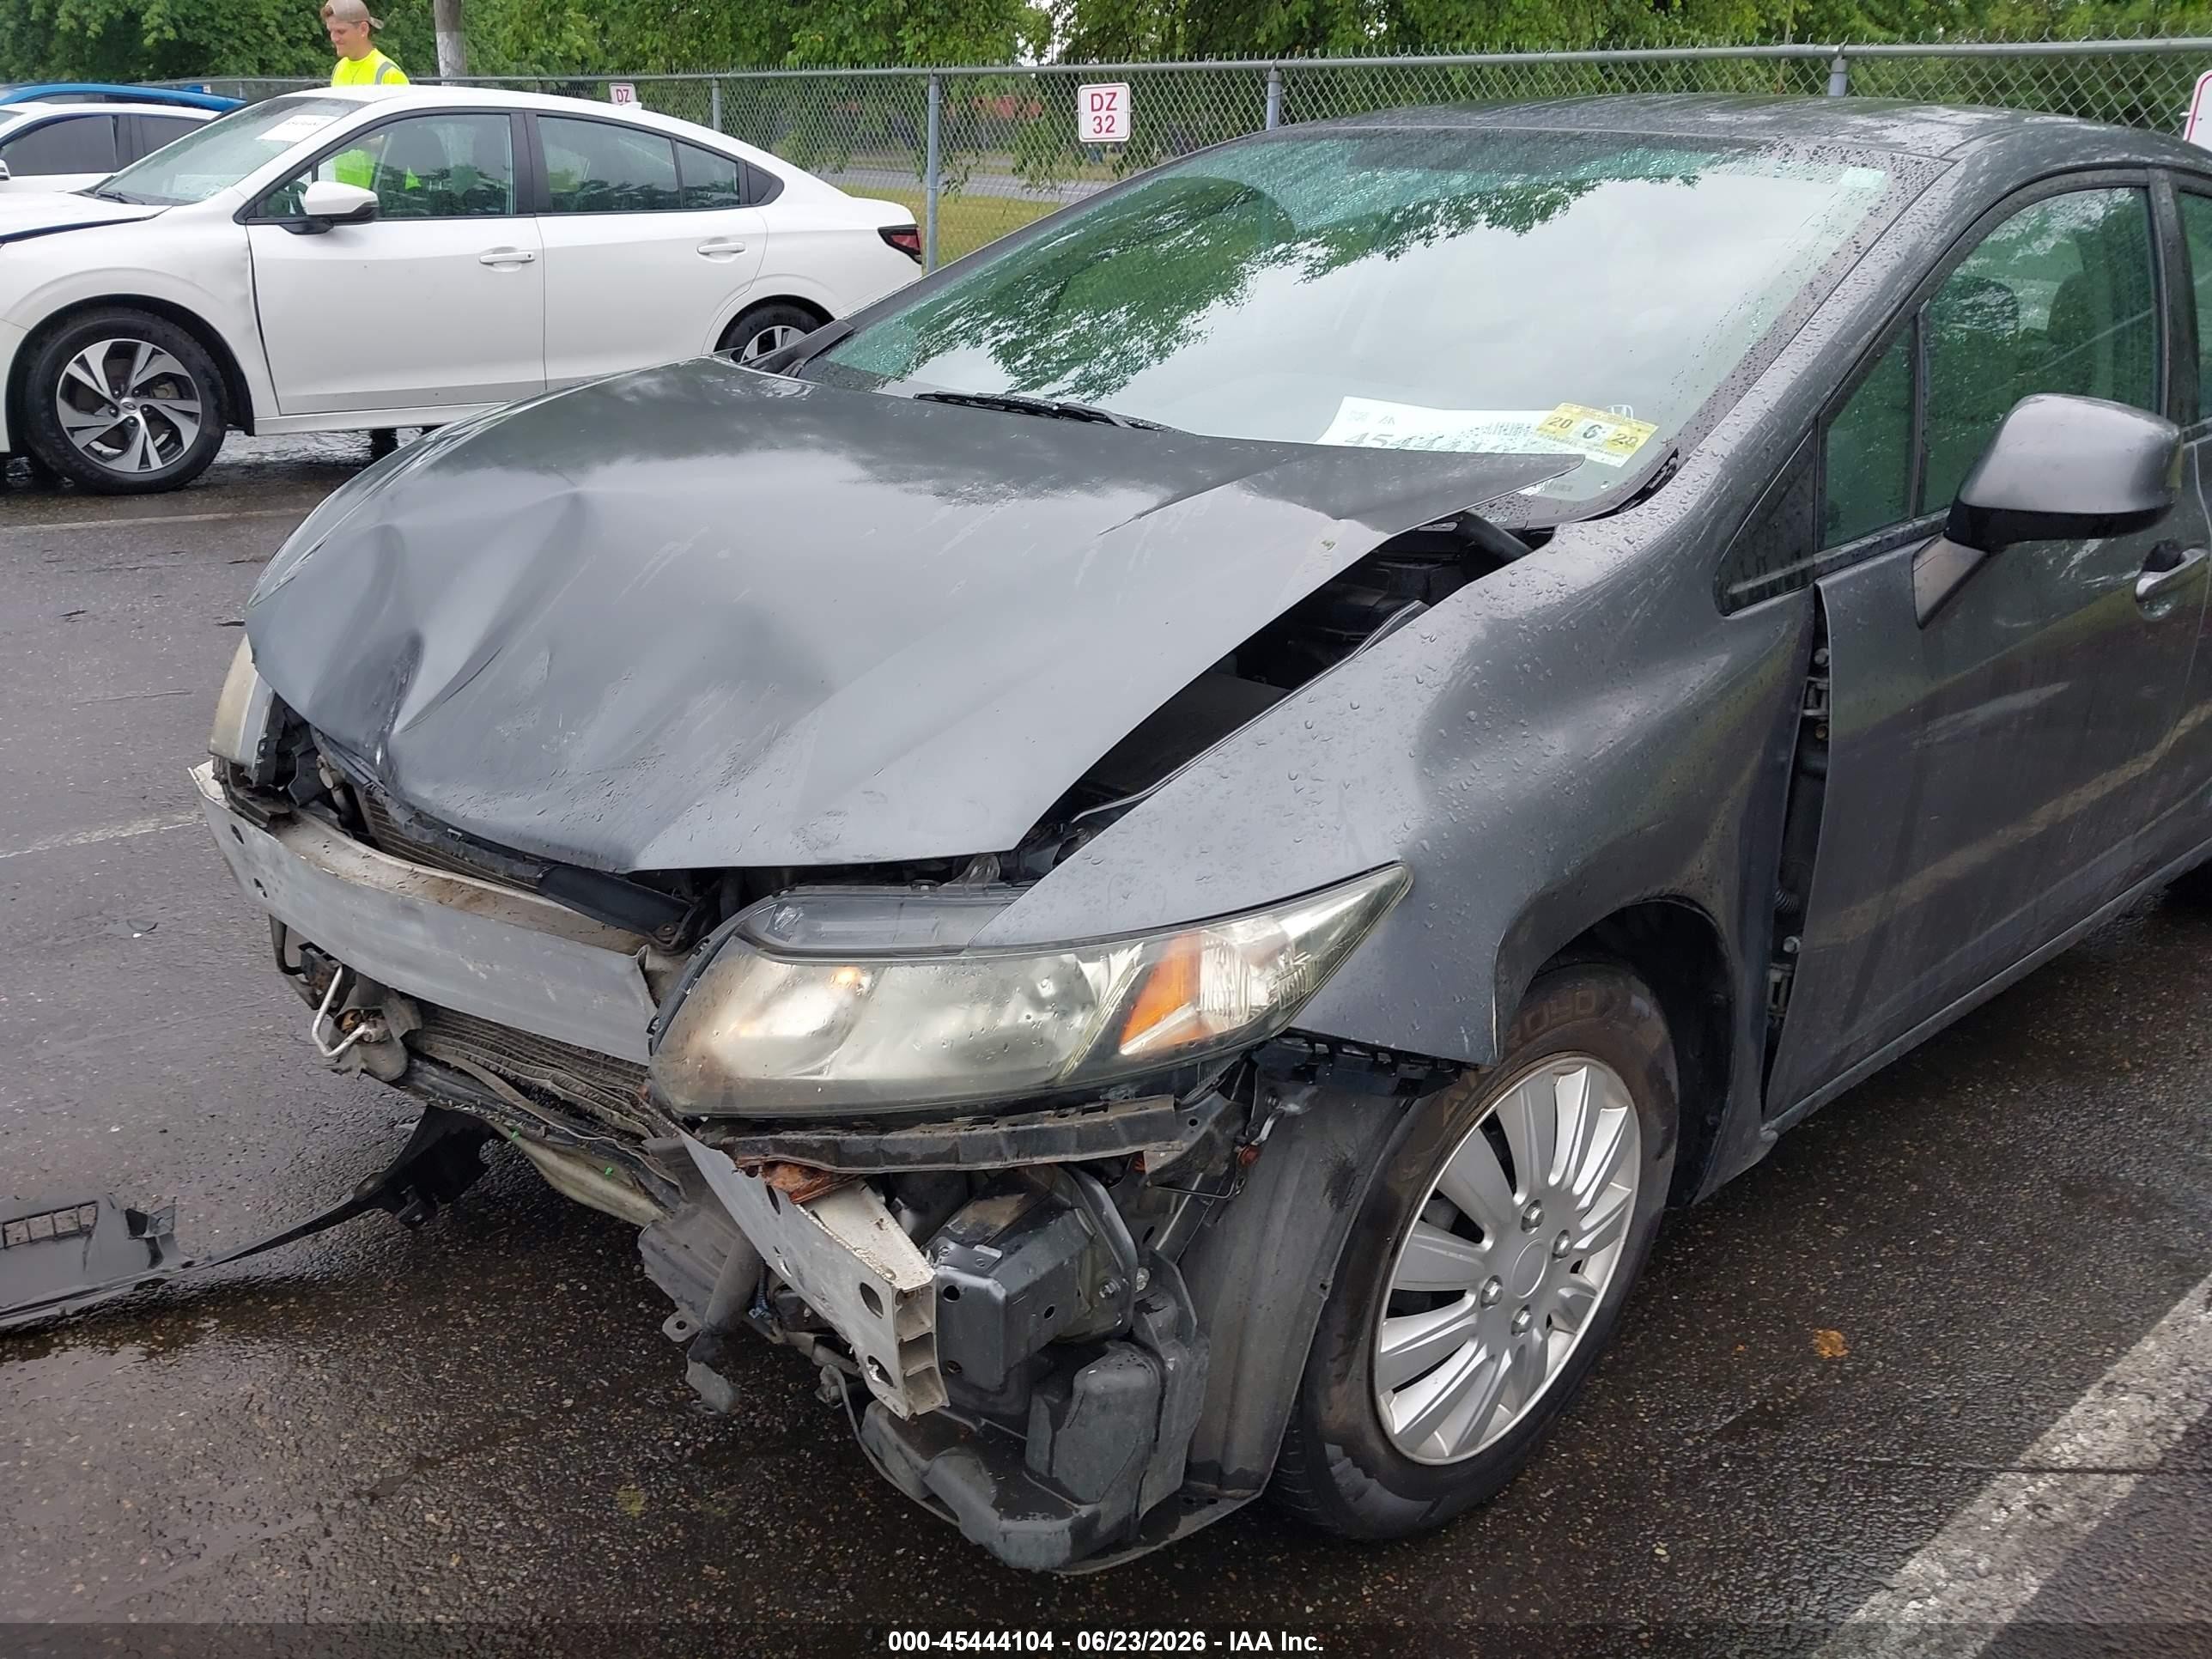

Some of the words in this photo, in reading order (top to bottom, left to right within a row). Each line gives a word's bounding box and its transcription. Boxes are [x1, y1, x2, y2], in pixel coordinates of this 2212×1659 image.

[616, 88, 631, 103] DZ
[1090, 91, 1118, 112] DZ
[1092, 114, 1115, 134] 32
[1547, 416, 1573, 428] 20
[1582, 424, 1602, 440] 6
